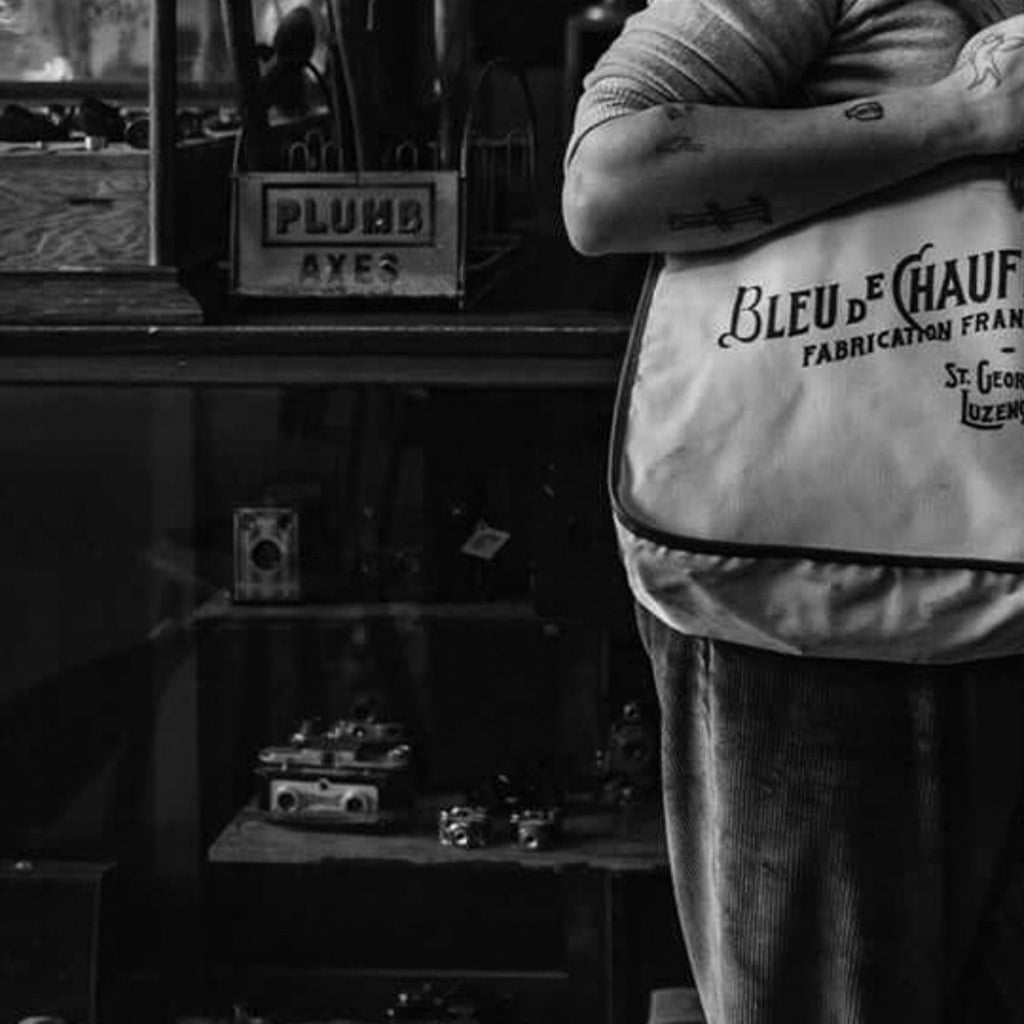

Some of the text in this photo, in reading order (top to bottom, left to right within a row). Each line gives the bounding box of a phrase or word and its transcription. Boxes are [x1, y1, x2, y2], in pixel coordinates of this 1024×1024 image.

[276, 198, 423, 235] PLUMB
[303, 254, 399, 282] AXES
[718, 284, 839, 349] BLEU
[847, 273, 884, 326] DE
[802, 320, 951, 367] FABRICATION
[944, 362, 971, 388] ST.
